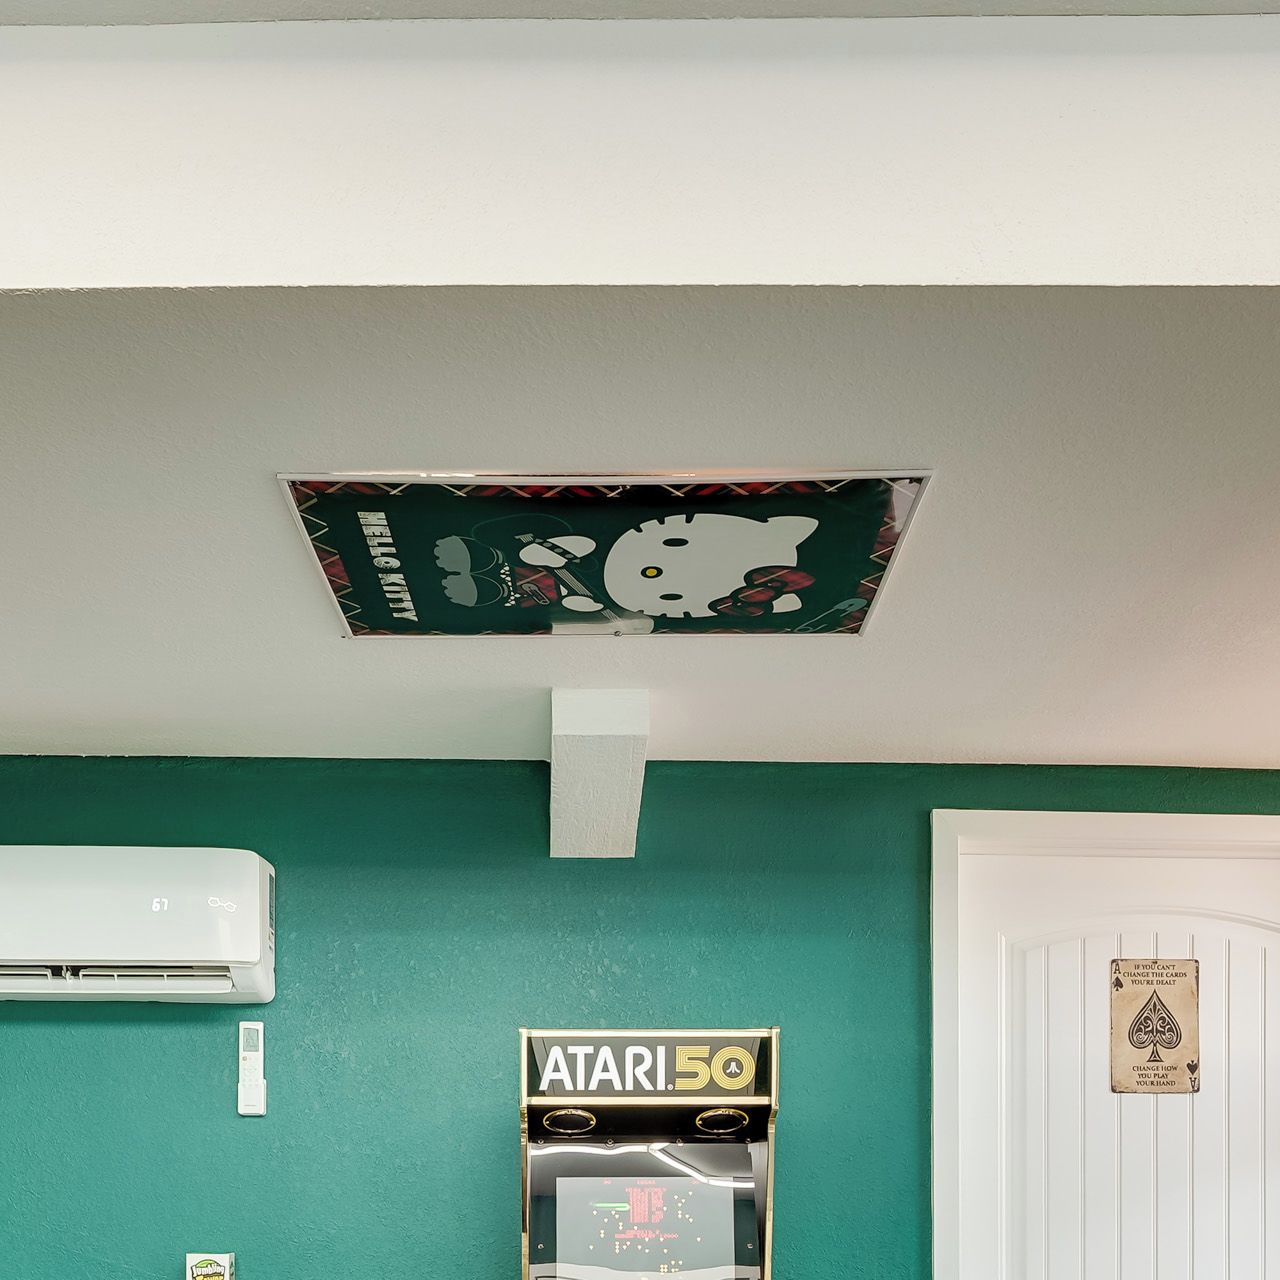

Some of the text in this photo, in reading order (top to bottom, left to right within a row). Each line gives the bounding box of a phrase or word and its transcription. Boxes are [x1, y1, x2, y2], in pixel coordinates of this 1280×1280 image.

[357, 511, 418, 621] HELLO KITTY
[538, 1045, 756, 1091] ATARI 50
[191, 1263, 225, 1277] Jumbling
